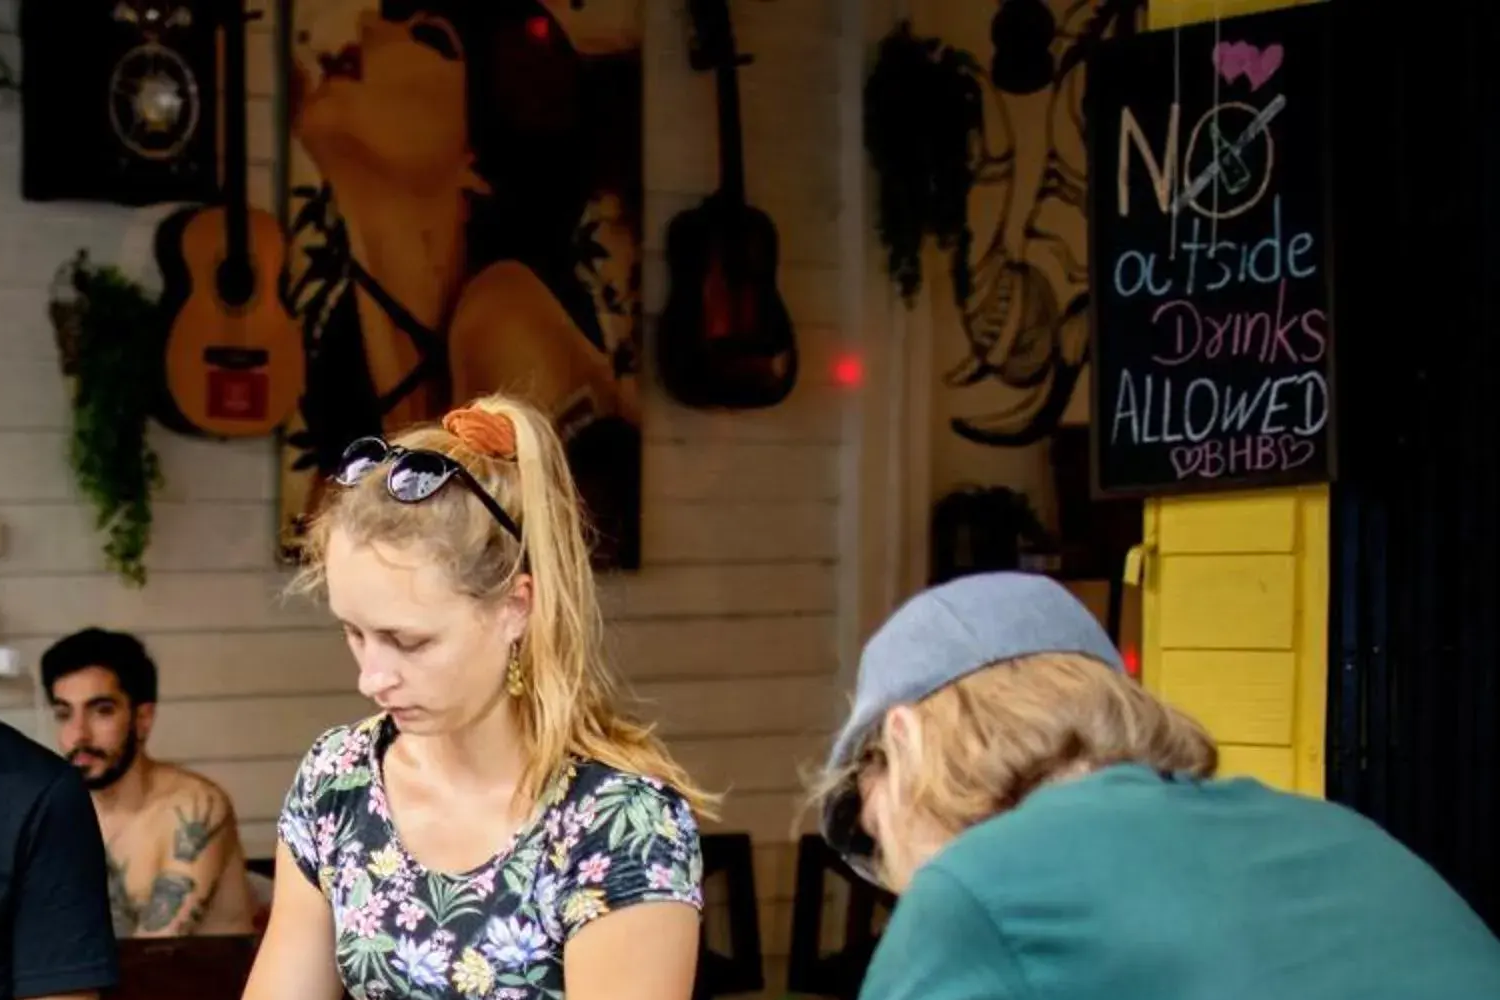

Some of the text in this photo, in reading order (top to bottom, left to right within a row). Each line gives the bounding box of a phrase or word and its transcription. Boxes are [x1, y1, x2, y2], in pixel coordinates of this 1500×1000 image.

[1117, 101, 1275, 219] NO
[1113, 194, 1317, 298] outside
[1151, 278, 1328, 366] Drinks
[1111, 367, 1330, 444] ALLOWED
[1199, 435, 1279, 477] BHB
